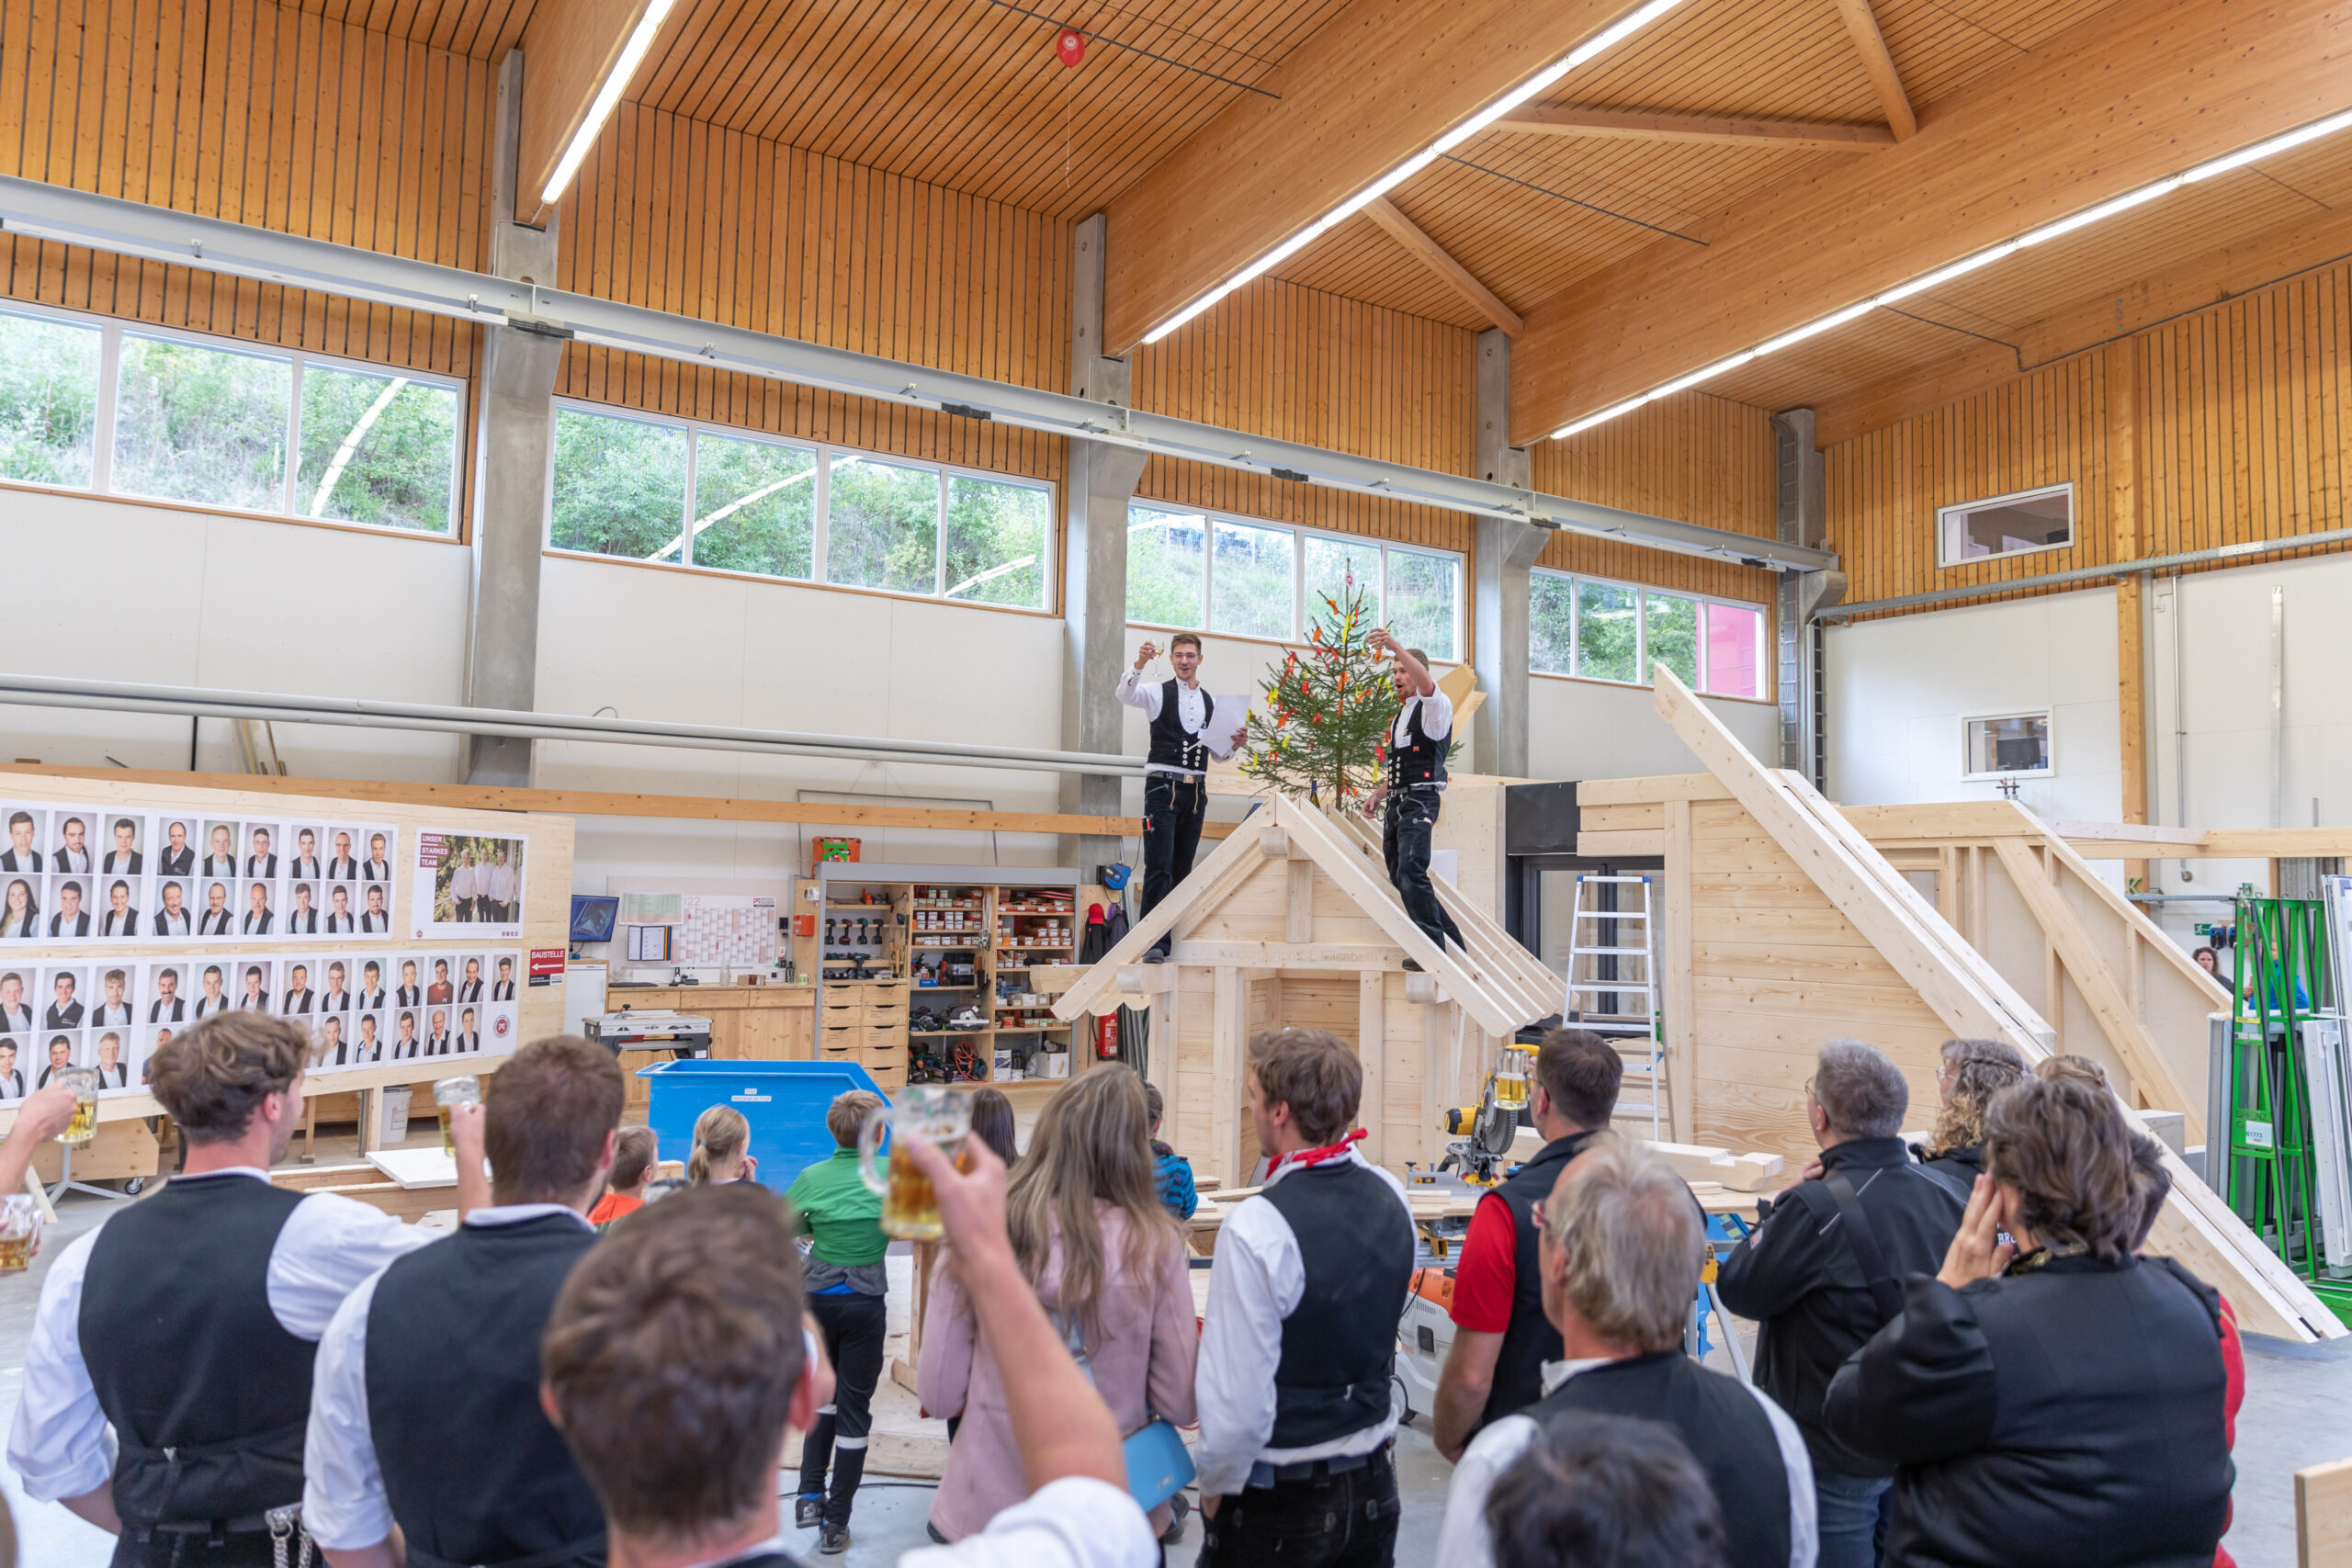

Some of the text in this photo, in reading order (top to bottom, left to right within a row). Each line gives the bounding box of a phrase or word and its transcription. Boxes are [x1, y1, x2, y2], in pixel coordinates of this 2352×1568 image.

[422, 835, 442, 843] UNSER
[422, 847, 448, 855] STARKES
[421, 858, 438, 866] TEAM
[531, 950, 564, 959] BAUSTELLE
